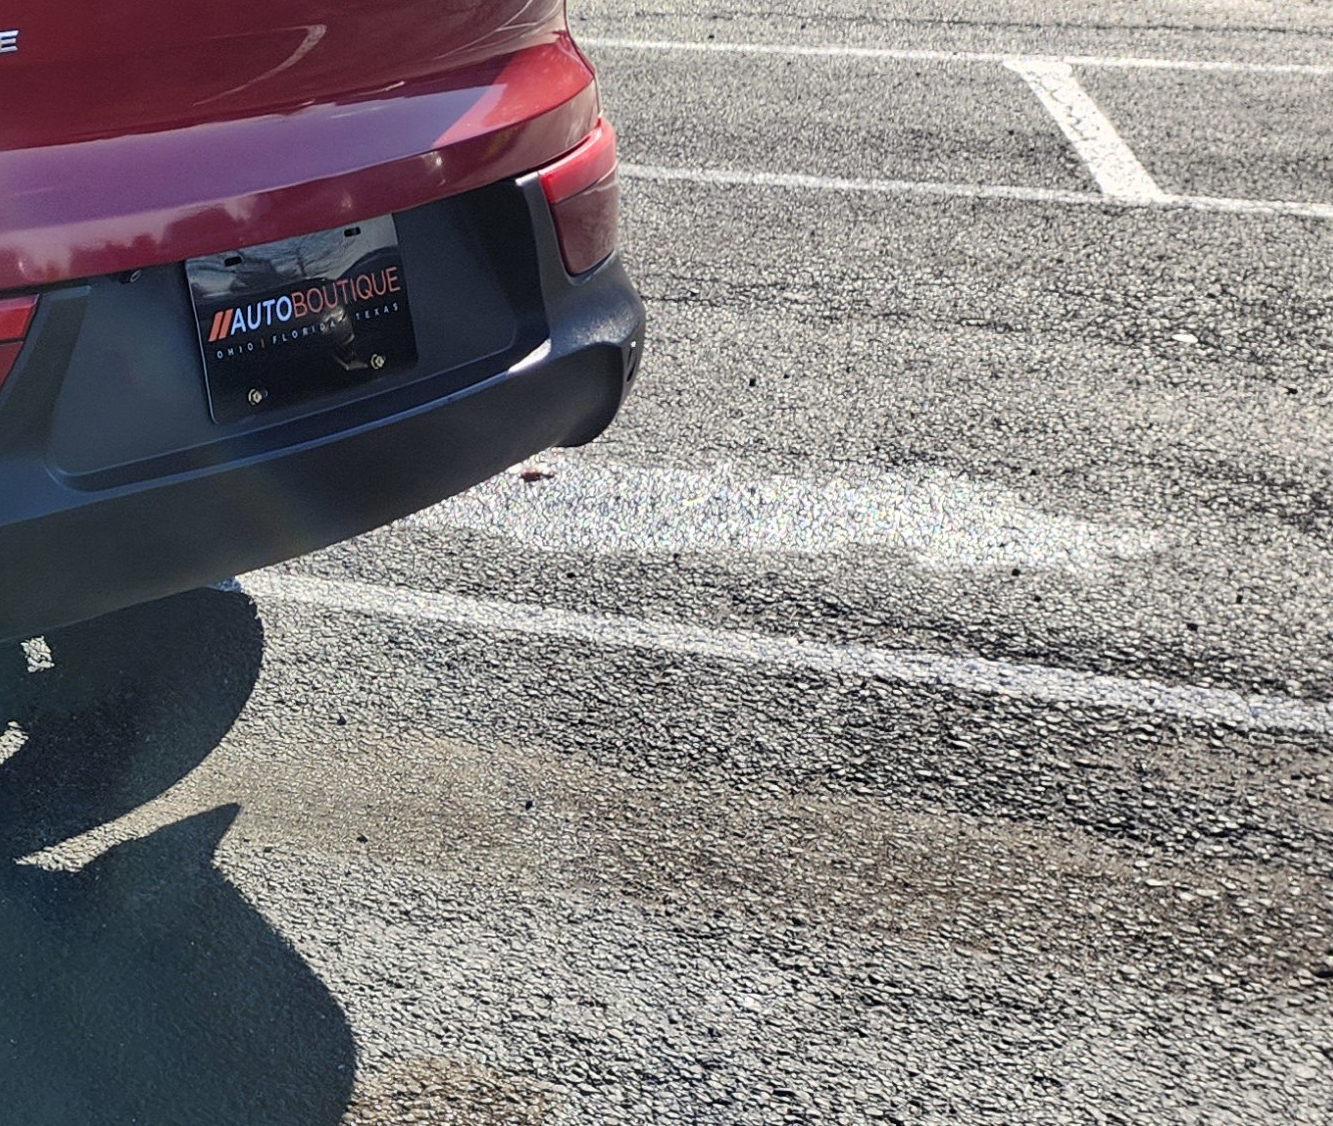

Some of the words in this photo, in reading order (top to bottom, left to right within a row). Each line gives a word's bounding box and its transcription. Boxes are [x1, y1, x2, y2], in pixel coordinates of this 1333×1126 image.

[216, 342, 254, 360] OHIO
[271, 320, 337, 344] FLORIDA
[355, 302, 400, 321] TEXAS
